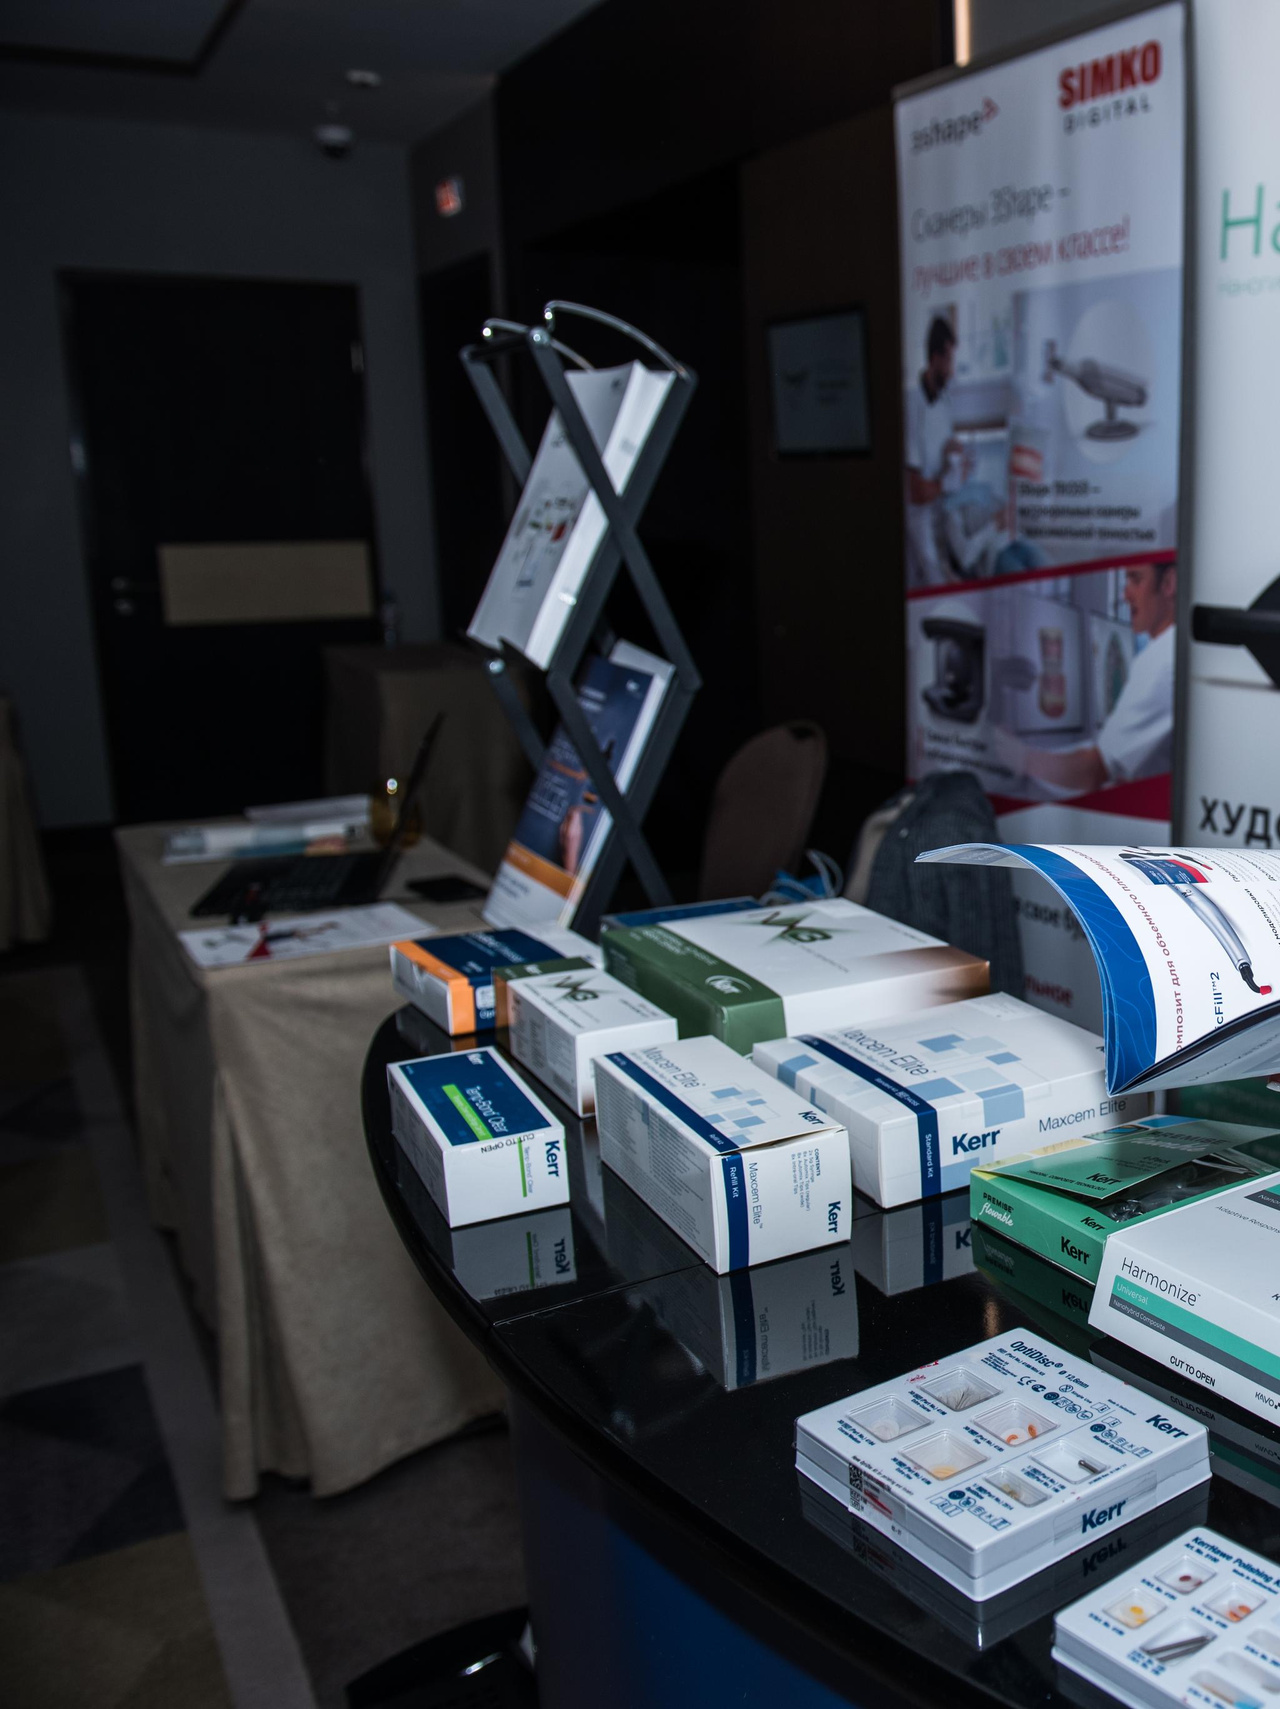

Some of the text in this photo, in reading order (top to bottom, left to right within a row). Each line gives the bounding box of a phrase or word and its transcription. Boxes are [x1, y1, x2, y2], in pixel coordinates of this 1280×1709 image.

[1058, 39, 1162, 110] SIMKO
[1166, 960, 1181, 986] для
[890, 1054, 930, 1076] Elite
[673, 1071, 701, 1089] Elite
[798, 1110, 825, 1125] Kerr
[1039, 1098, 1128, 1133] Maxcem Elite
[480, 1140, 505, 1154] OPEN
[925, 1133, 934, 1167] Standard
[952, 1128, 1002, 1156] Kerr
[545, 1139, 562, 1178] Kerr
[729, 1166, 738, 1187] Refill
[749, 1162, 760, 1204] Maxcem
[1086, 1172, 1123, 1185] Kerr
[827, 1200, 841, 1233] Kerr
[979, 1202, 1014, 1227] flowable
[1080, 1216, 1106, 1231] Kerr
[1215, 1205, 1249, 1221] Adaptive
[1061, 1236, 1091, 1265] Kerr
[1117, 1282, 1148, 1306] Universal
[1121, 1257, 1197, 1307] Harmonize
[1113, 1299, 1166, 1332] Nanohybrid Composite
[1170, 1356, 1216, 1387] CUT TO OPEN
[1145, 1414, 1189, 1439] Kerr
[1082, 1500, 1127, 1534] Kerr
[1233, 1557, 1274, 1584] Polishing
